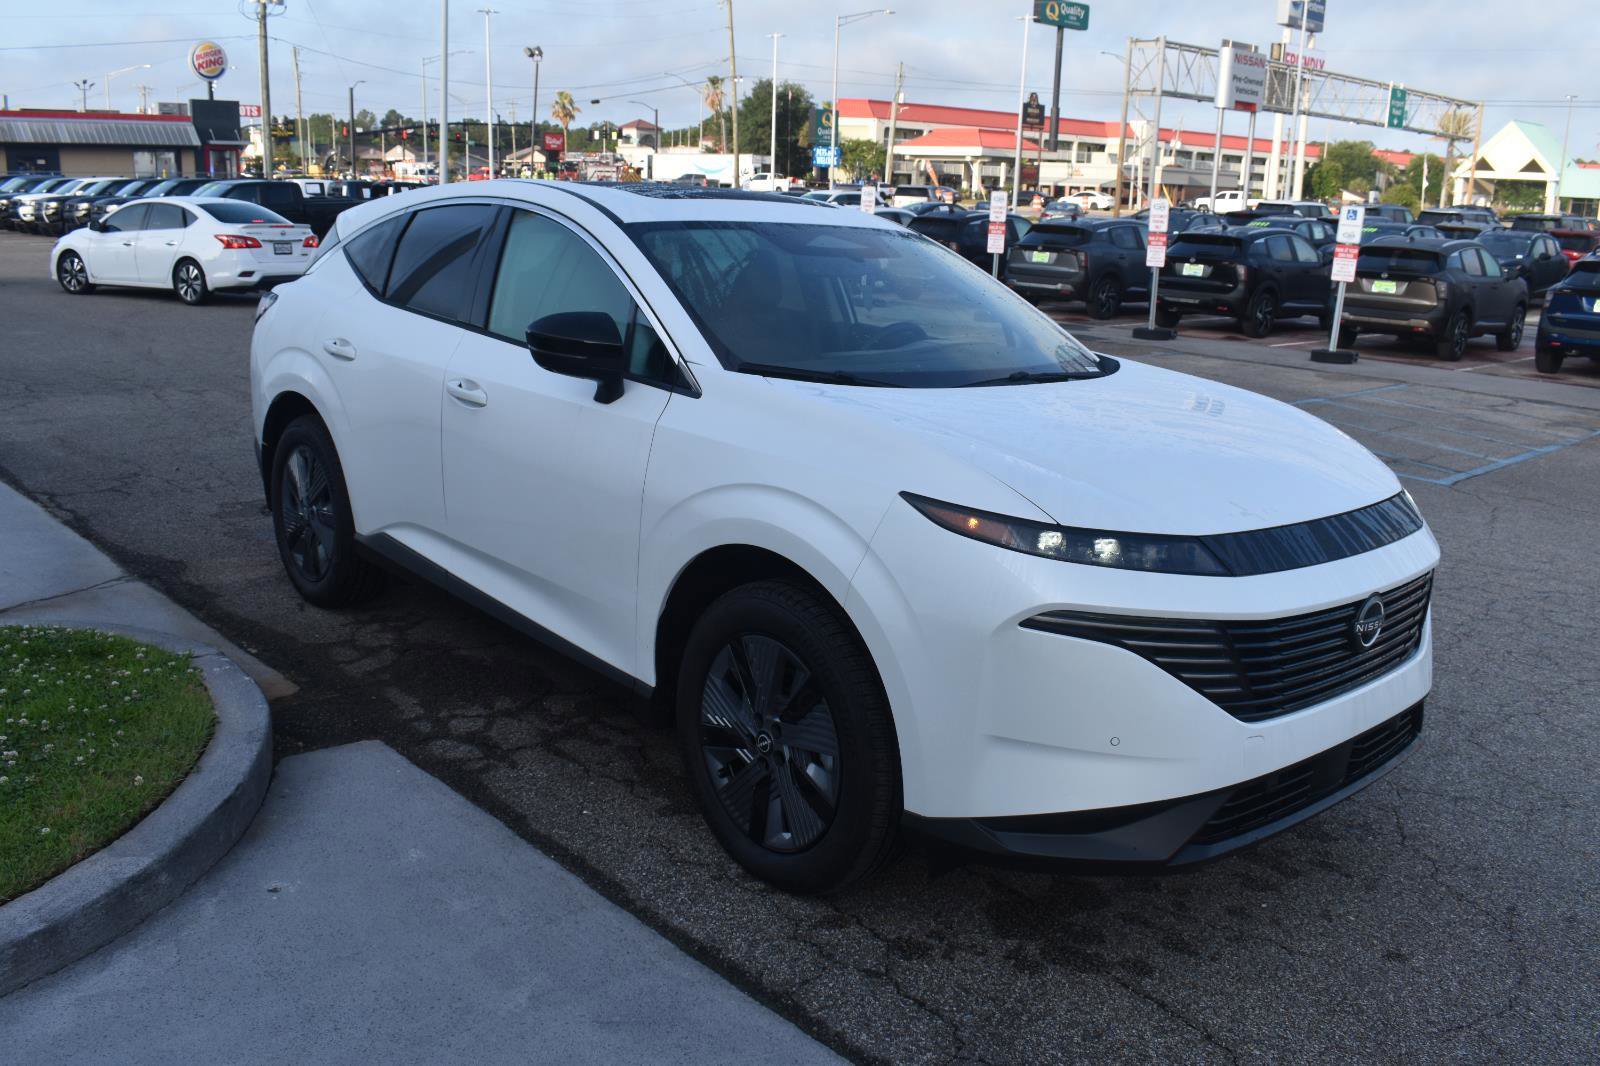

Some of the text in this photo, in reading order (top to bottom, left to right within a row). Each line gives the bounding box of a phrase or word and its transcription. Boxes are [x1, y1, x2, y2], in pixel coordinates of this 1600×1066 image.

[1061, 2, 1085, 19] Quality
[195, 49, 223, 61] BURGER
[1233, 53, 1265, 69] NISSAN
[197, 56, 225, 71] KING
[1232, 74, 1264, 87] Pre-Owned
[1235, 86, 1259, 97] Vehicles
[1356, 621, 1382, 632] NISS
